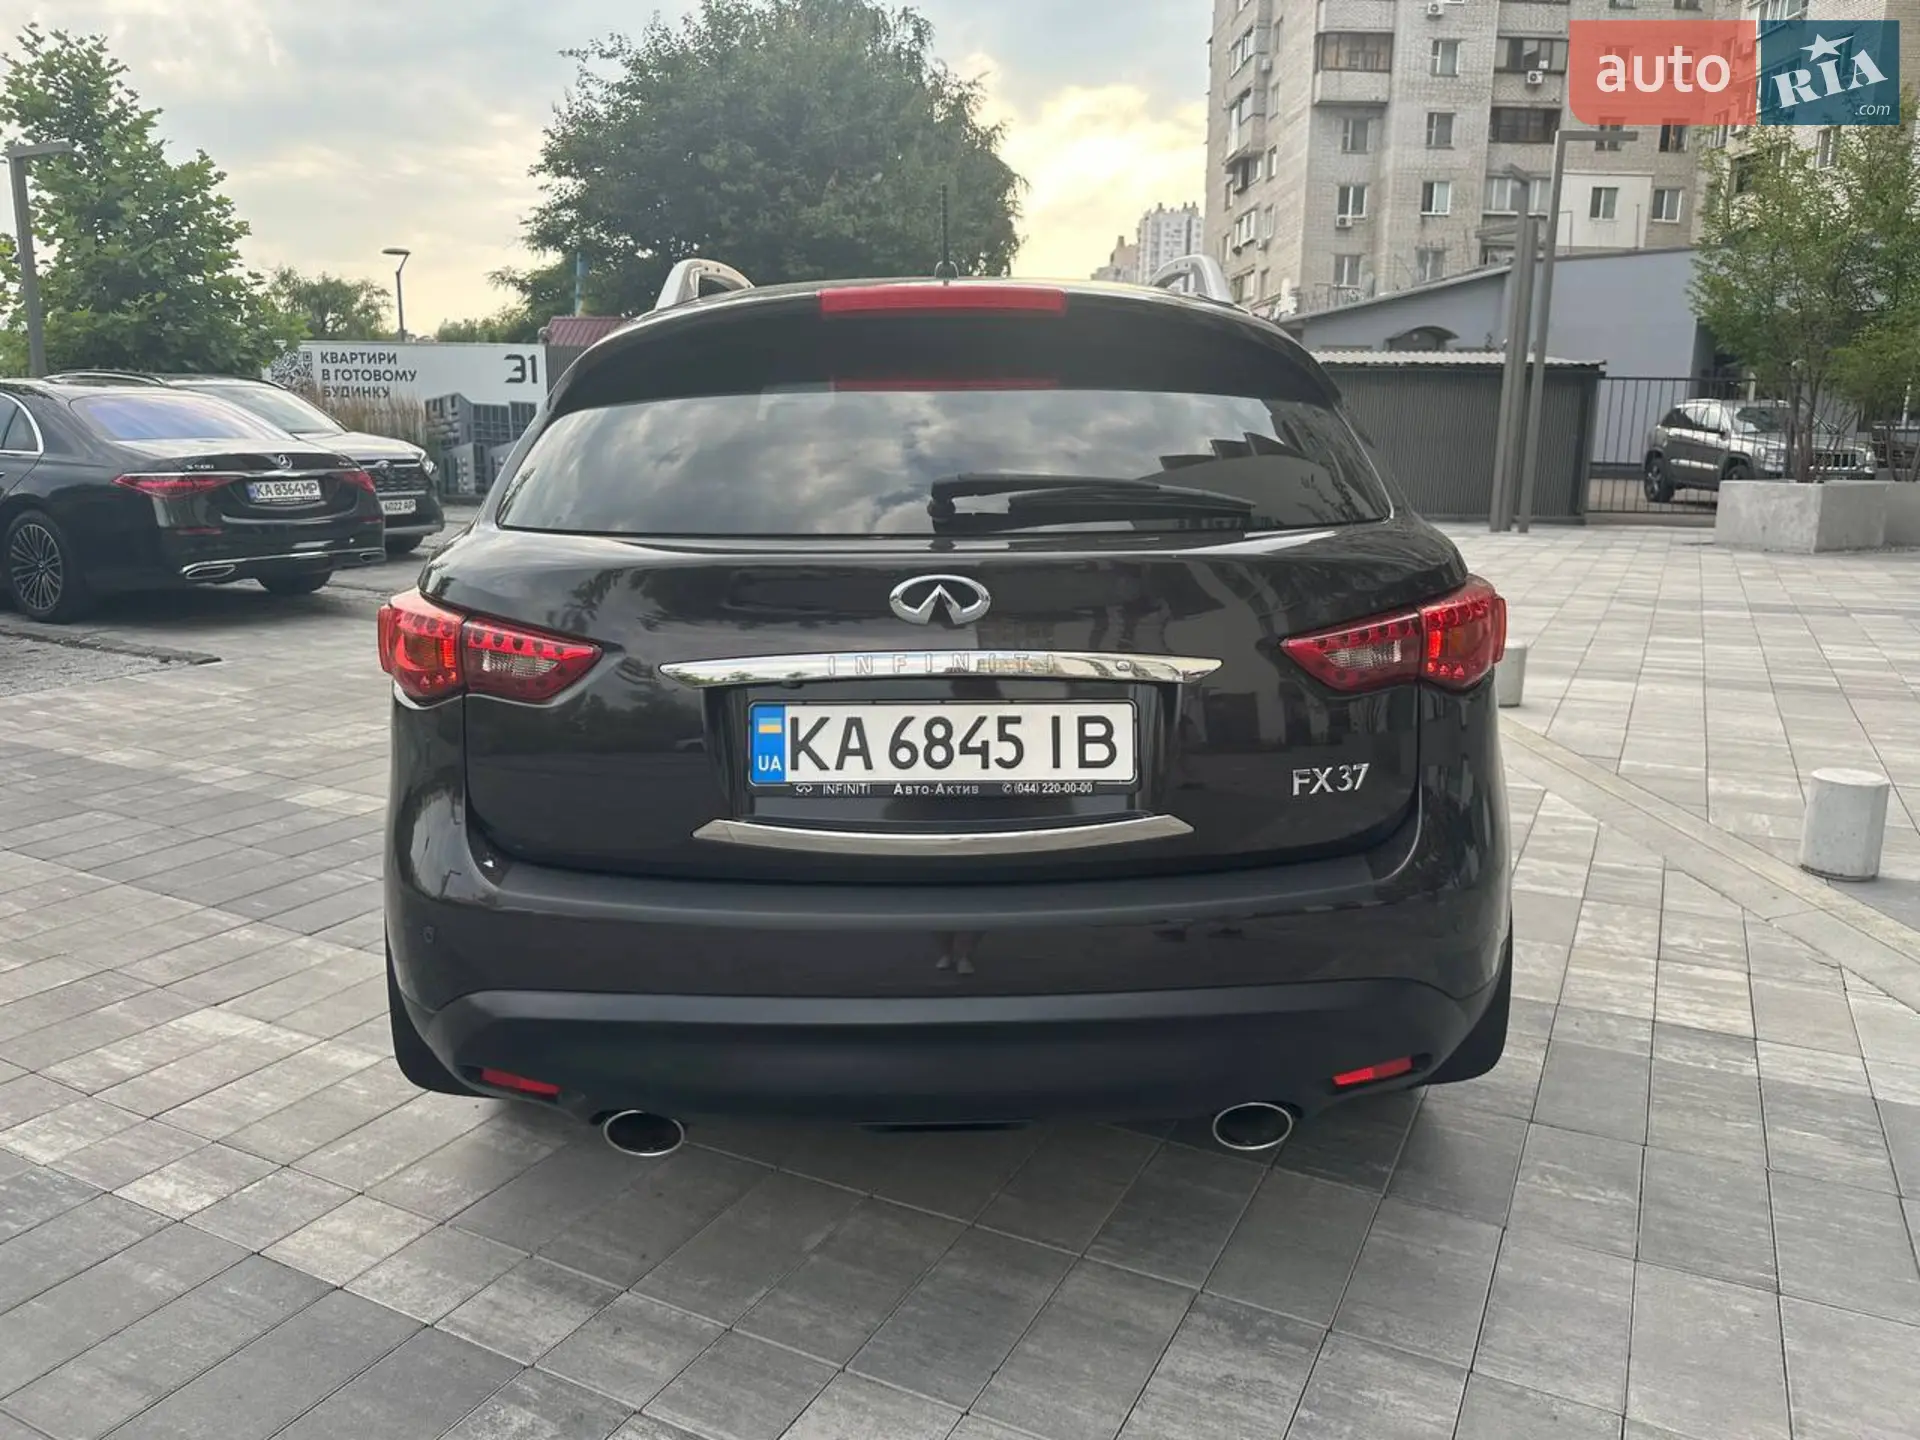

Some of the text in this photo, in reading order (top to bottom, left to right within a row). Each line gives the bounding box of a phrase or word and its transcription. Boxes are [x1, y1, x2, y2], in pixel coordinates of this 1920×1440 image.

[320, 351, 397, 365] КВАРТИРИ
[322, 369, 417, 383] В ГОТОВОМУ
[503, 354, 538, 384] 31
[323, 385, 390, 399] БУДИНКУ
[255, 483, 274, 496] KA
[827, 653, 1055, 675] INFINITI
[789, 715, 1118, 771] KA 6845 IB
[758, 757, 782, 772] UA
[822, 782, 872, 795] INFINITI
[1013, 782, 1093, 795] (044) 220-00-00
